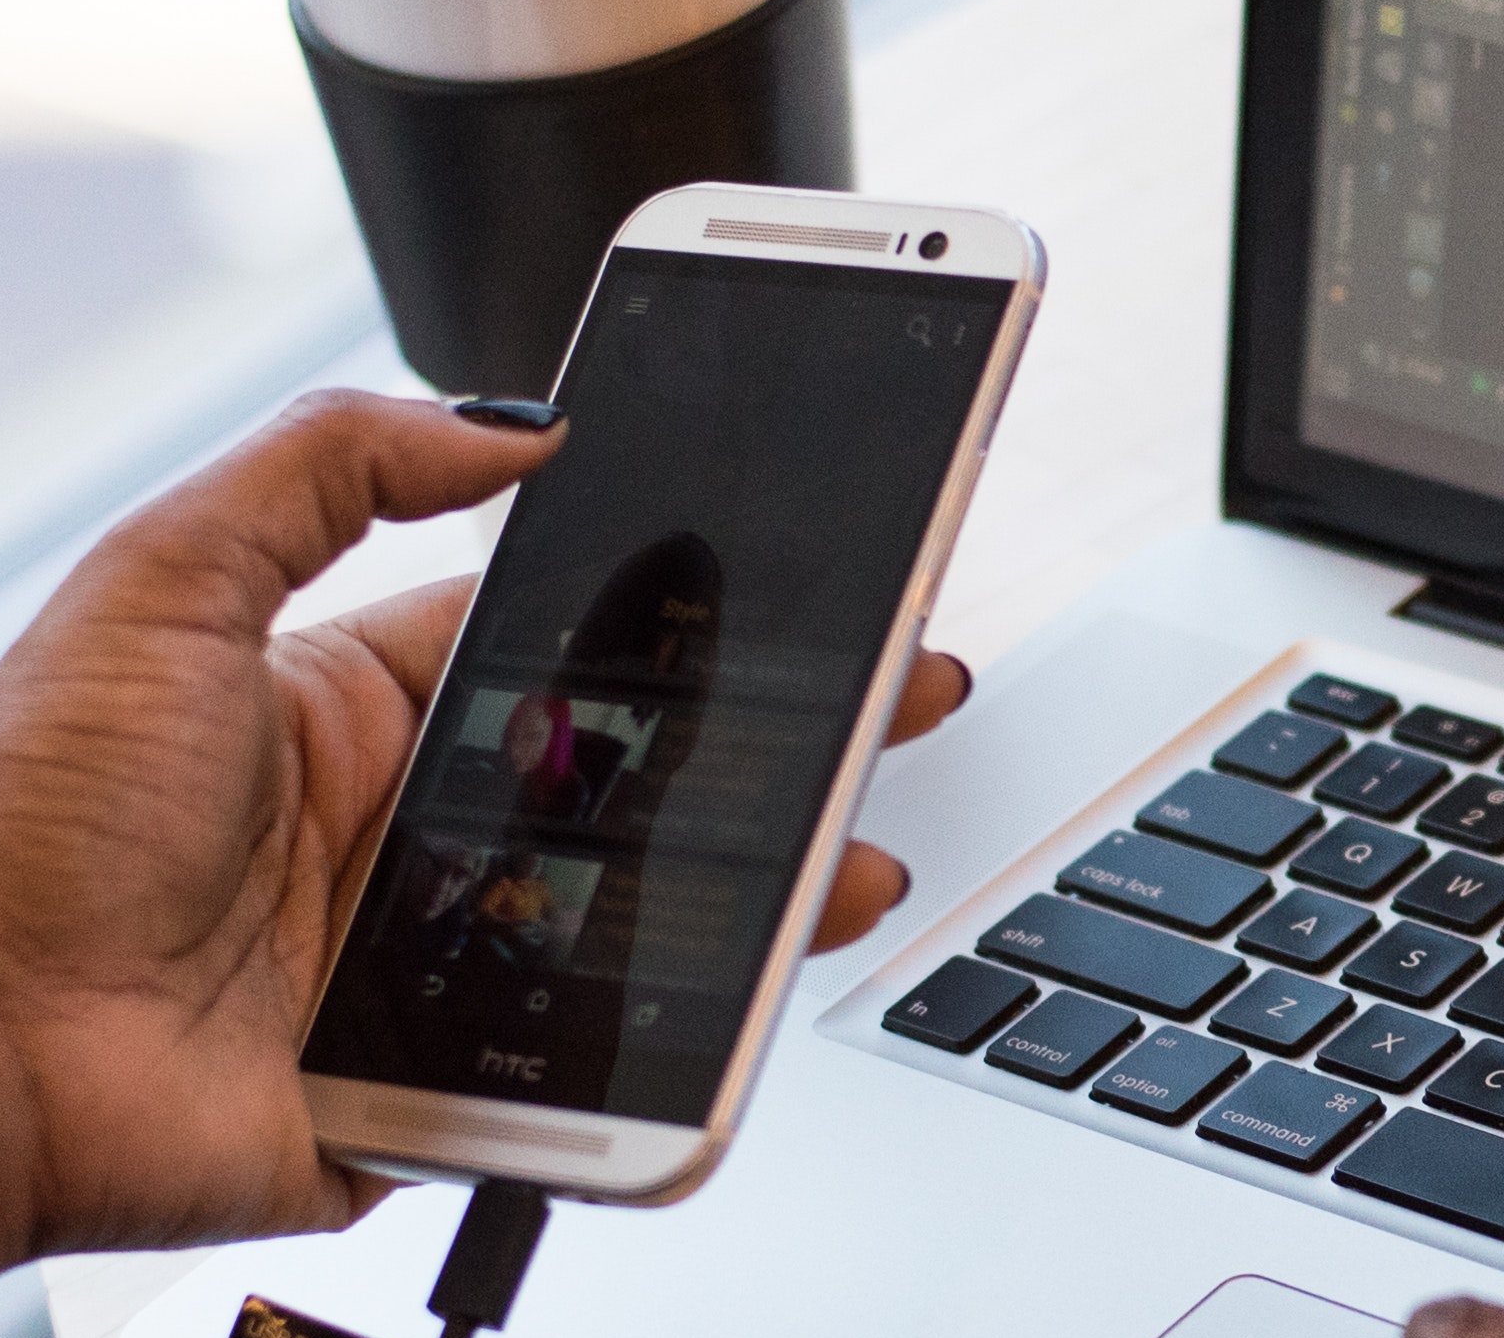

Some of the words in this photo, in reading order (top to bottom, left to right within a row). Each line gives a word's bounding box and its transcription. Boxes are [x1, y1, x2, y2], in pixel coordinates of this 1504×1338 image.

[1343, 843, 1373, 864] Q
[1080, 866, 1125, 887] caps
[1125, 878, 1164, 900] lock
[1446, 875, 1483, 898] W
[1291, 915, 1318, 936] A
[1002, 929, 1046, 949] shift
[1400, 949, 1428, 968] S
[908, 1000, 929, 1016] fn
[1266, 996, 1299, 1018] Z
[1005, 1033, 1072, 1065] control
[1372, 1032, 1405, 1054] X
[1111, 1073, 1170, 1099] option
[1221, 1107, 1316, 1148] command
